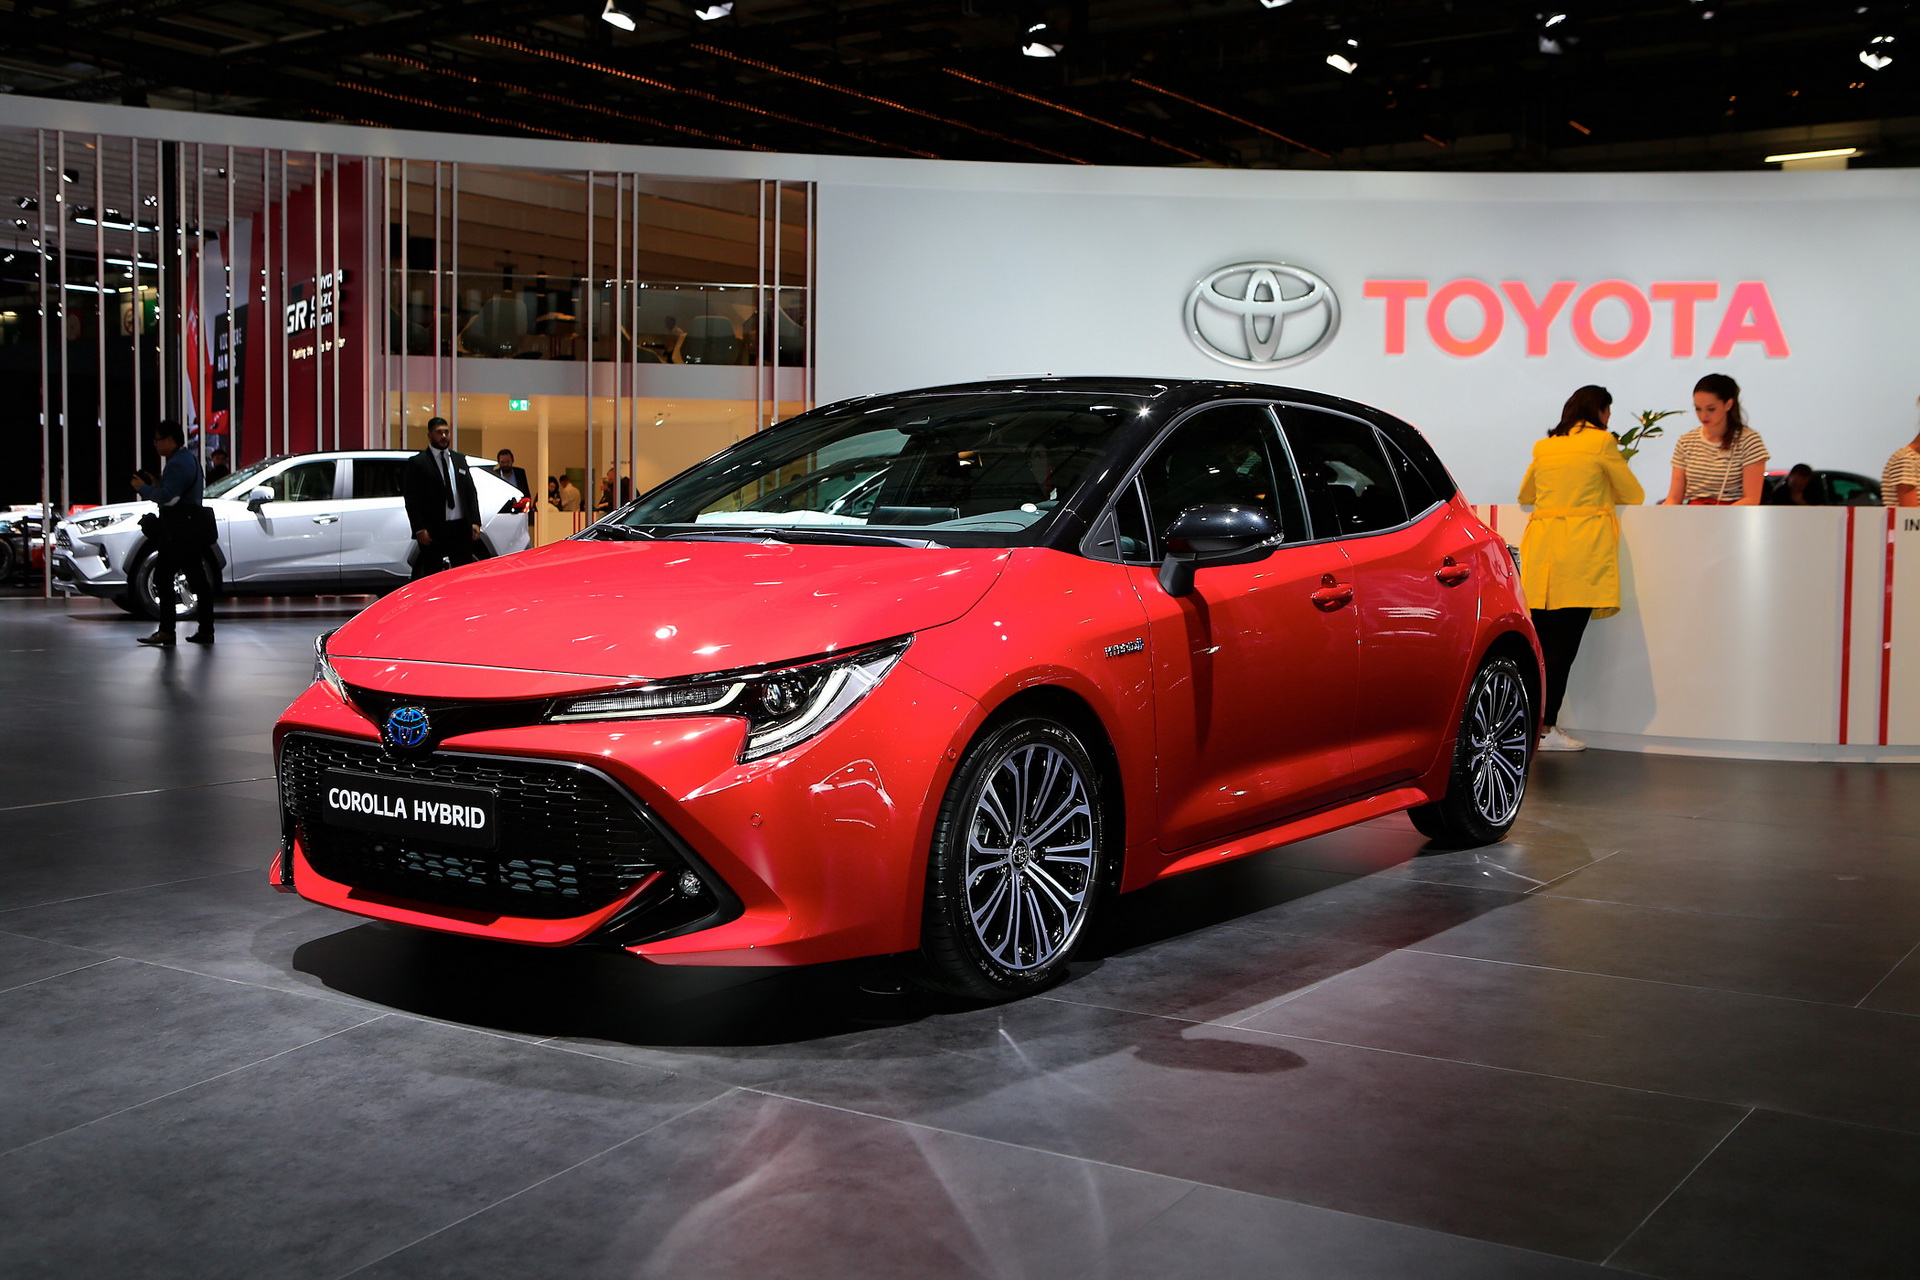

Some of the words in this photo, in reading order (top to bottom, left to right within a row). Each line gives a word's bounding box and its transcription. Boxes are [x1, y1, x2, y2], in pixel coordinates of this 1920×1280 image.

[311, 269, 343, 290] YOA
[286, 299, 308, 334] GR
[310, 309, 333, 329] Rcin
[1363, 278, 1791, 358] TOYOTA
[328, 787, 408, 819] COROLLA
[413, 799, 486, 830] HYBRID
